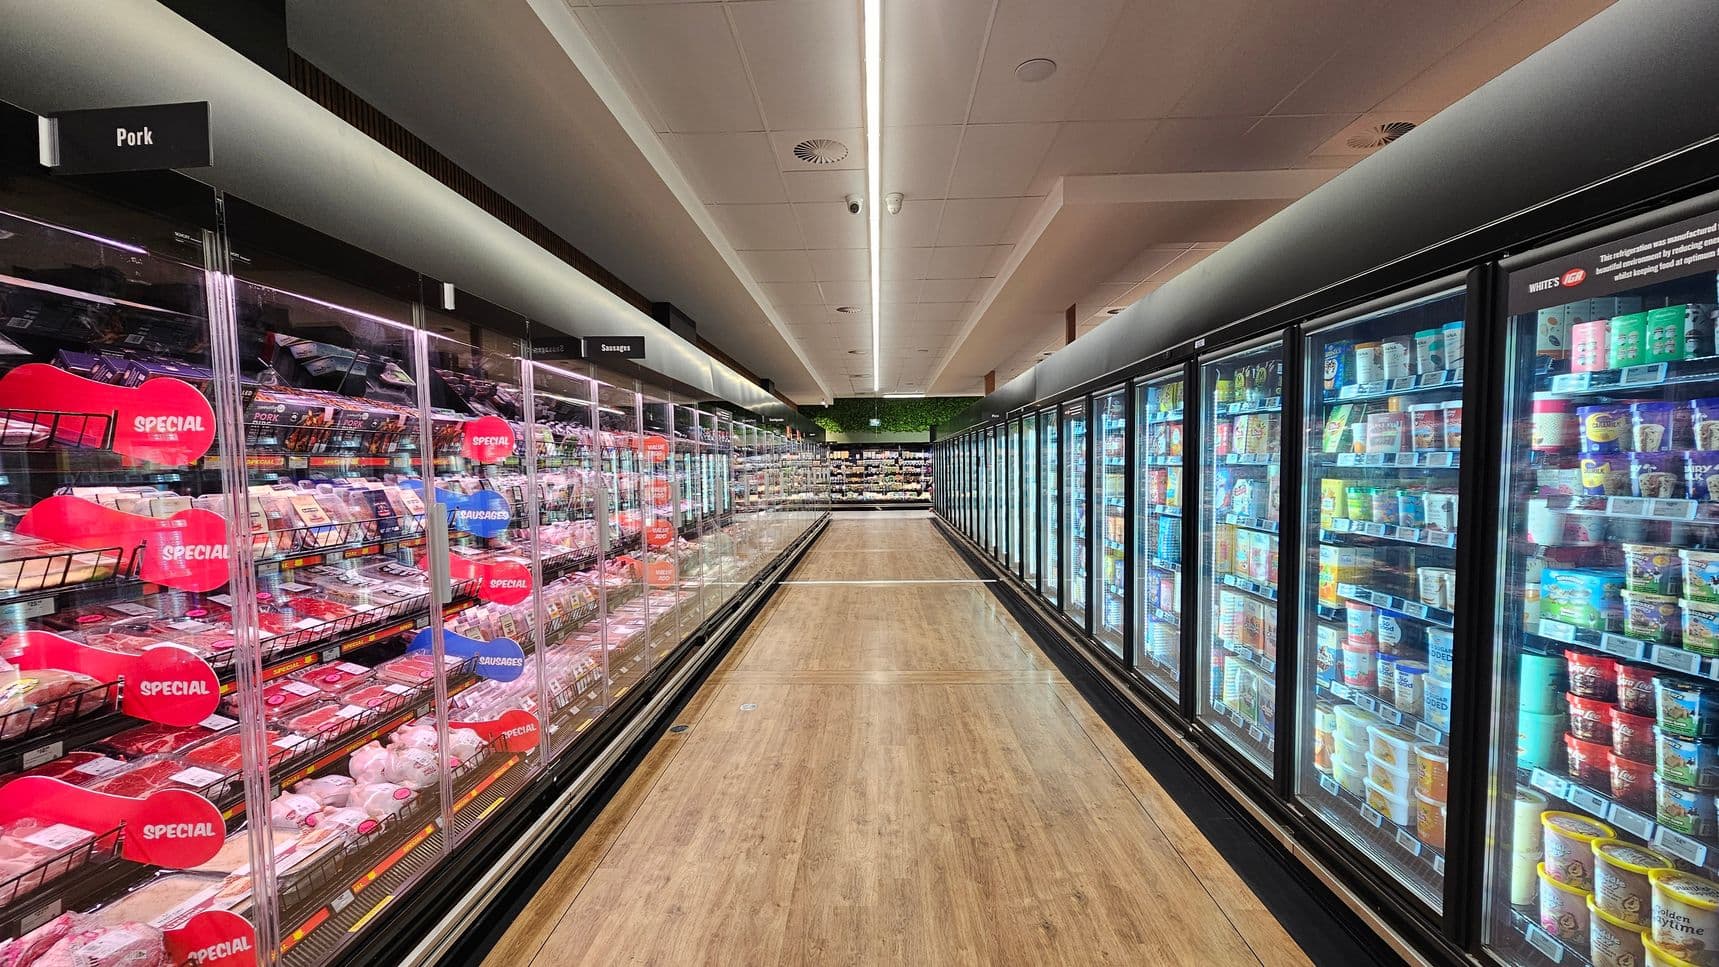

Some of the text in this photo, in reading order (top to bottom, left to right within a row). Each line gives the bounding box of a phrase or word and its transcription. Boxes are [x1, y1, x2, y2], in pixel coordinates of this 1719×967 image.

[116, 126, 153, 147] Pork
[1600, 253, 1612, 262] This
[1653, 239, 1666, 248] was
[1667, 222, 1717, 244] manufactured
[1672, 241, 1703, 255] reducing
[1529, 270, 1585, 293] WHITE'S IGA
[601, 344, 630, 352] Sausages
[134, 415, 205, 433] SPECIAL
[253, 412, 280, 422] PORK
[472, 436, 510, 446] SPECIAL
[460, 509, 510, 520] SAUSAGES
[162, 543, 231, 561] SPECIAL
[490, 578, 527, 589] SPECIAL
[478, 655, 523, 667] SAUSAGES
[140, 680, 210, 696] SPECIAL
[143, 822, 216, 840] SPECIAL
